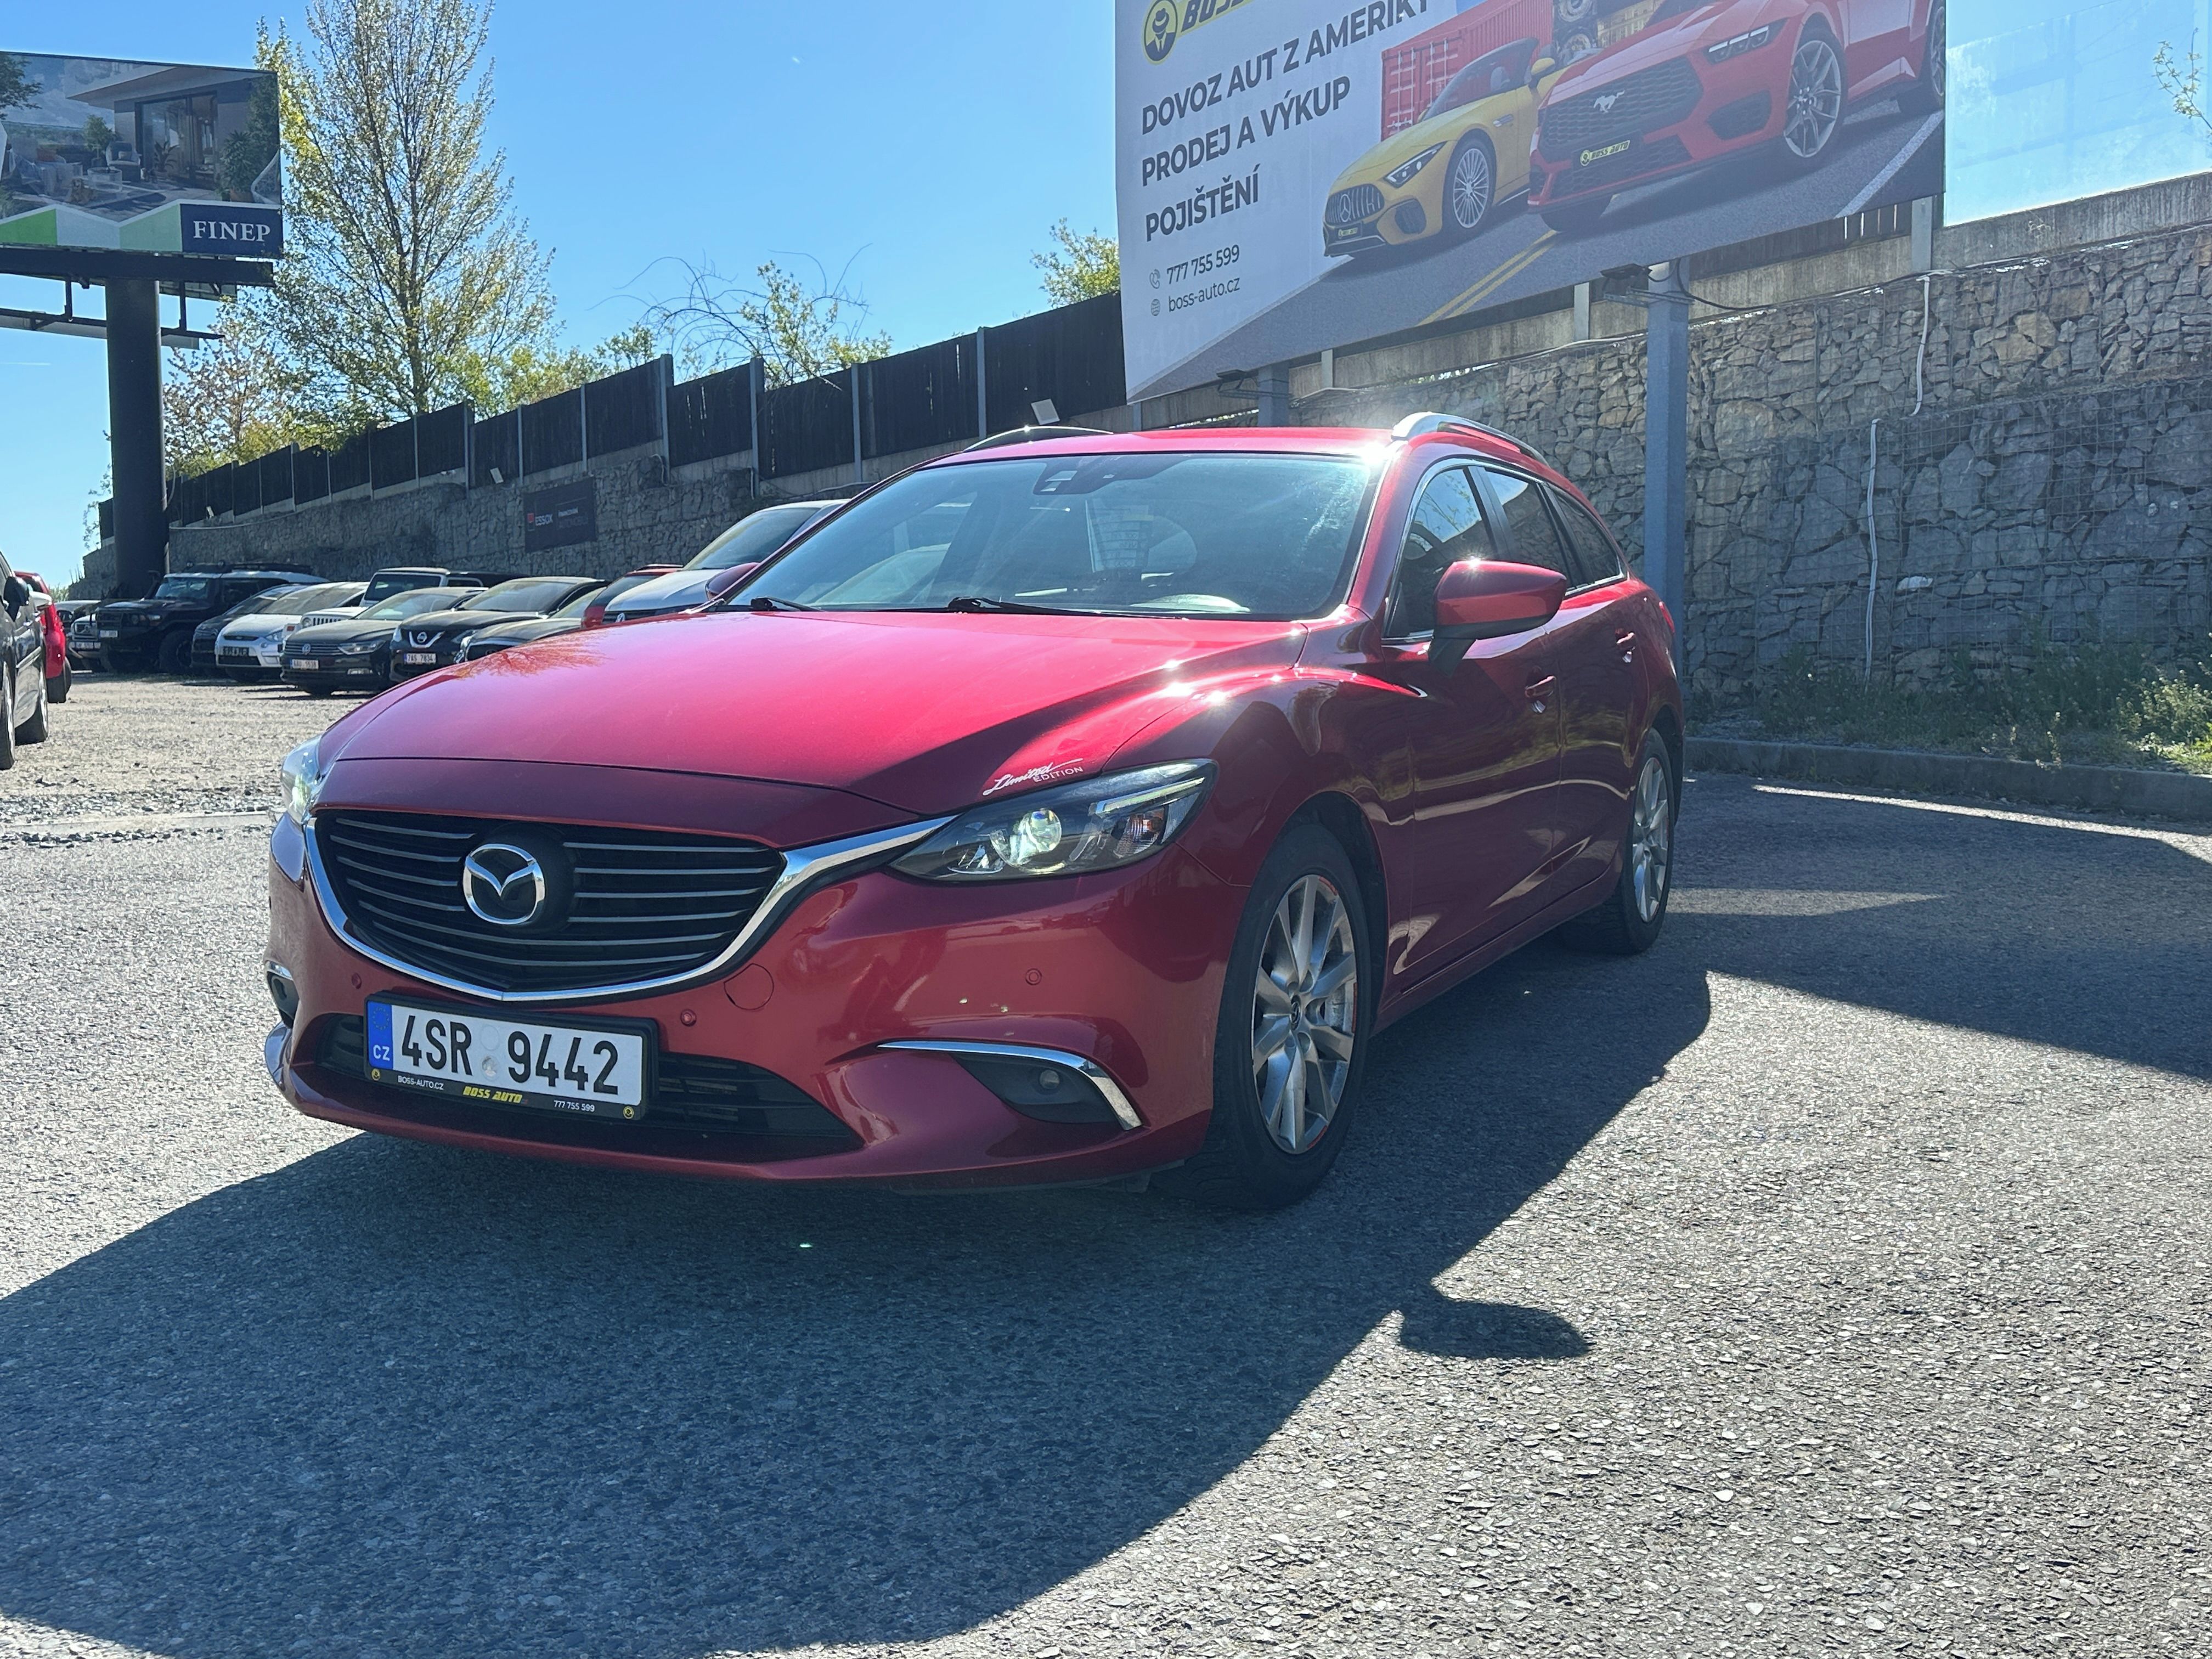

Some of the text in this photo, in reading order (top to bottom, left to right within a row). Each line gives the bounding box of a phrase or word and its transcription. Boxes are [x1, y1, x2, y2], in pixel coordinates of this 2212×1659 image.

[1181, 0, 1244, 32] BO
[1143, 74, 1222, 134] DOVOZ
[1227, 48, 1277, 98] AUT
[1284, 38, 1299, 74] Z
[1143, 76, 1350, 187] PRODEJ A VÝKUP
[1146, 164, 1260, 242] POJIŠTĚNÍ
[193, 221, 270, 241] FINEP
[1167, 245, 1239, 284] 777 755 599
[1169, 278, 1240, 312] boss-auto.cz
[983, 758, 1084, 795] Limited
[1033, 766, 1084, 782] EDITION
[373, 1045, 390, 1061] CZ
[402, 1015, 618, 1095] 4SR 9442
[398, 1075, 444, 1090] BOSS-AUTO.CZ
[462, 1086, 522, 1103] BOSS AUTO
[554, 1100, 595, 1112] 777 755 599
